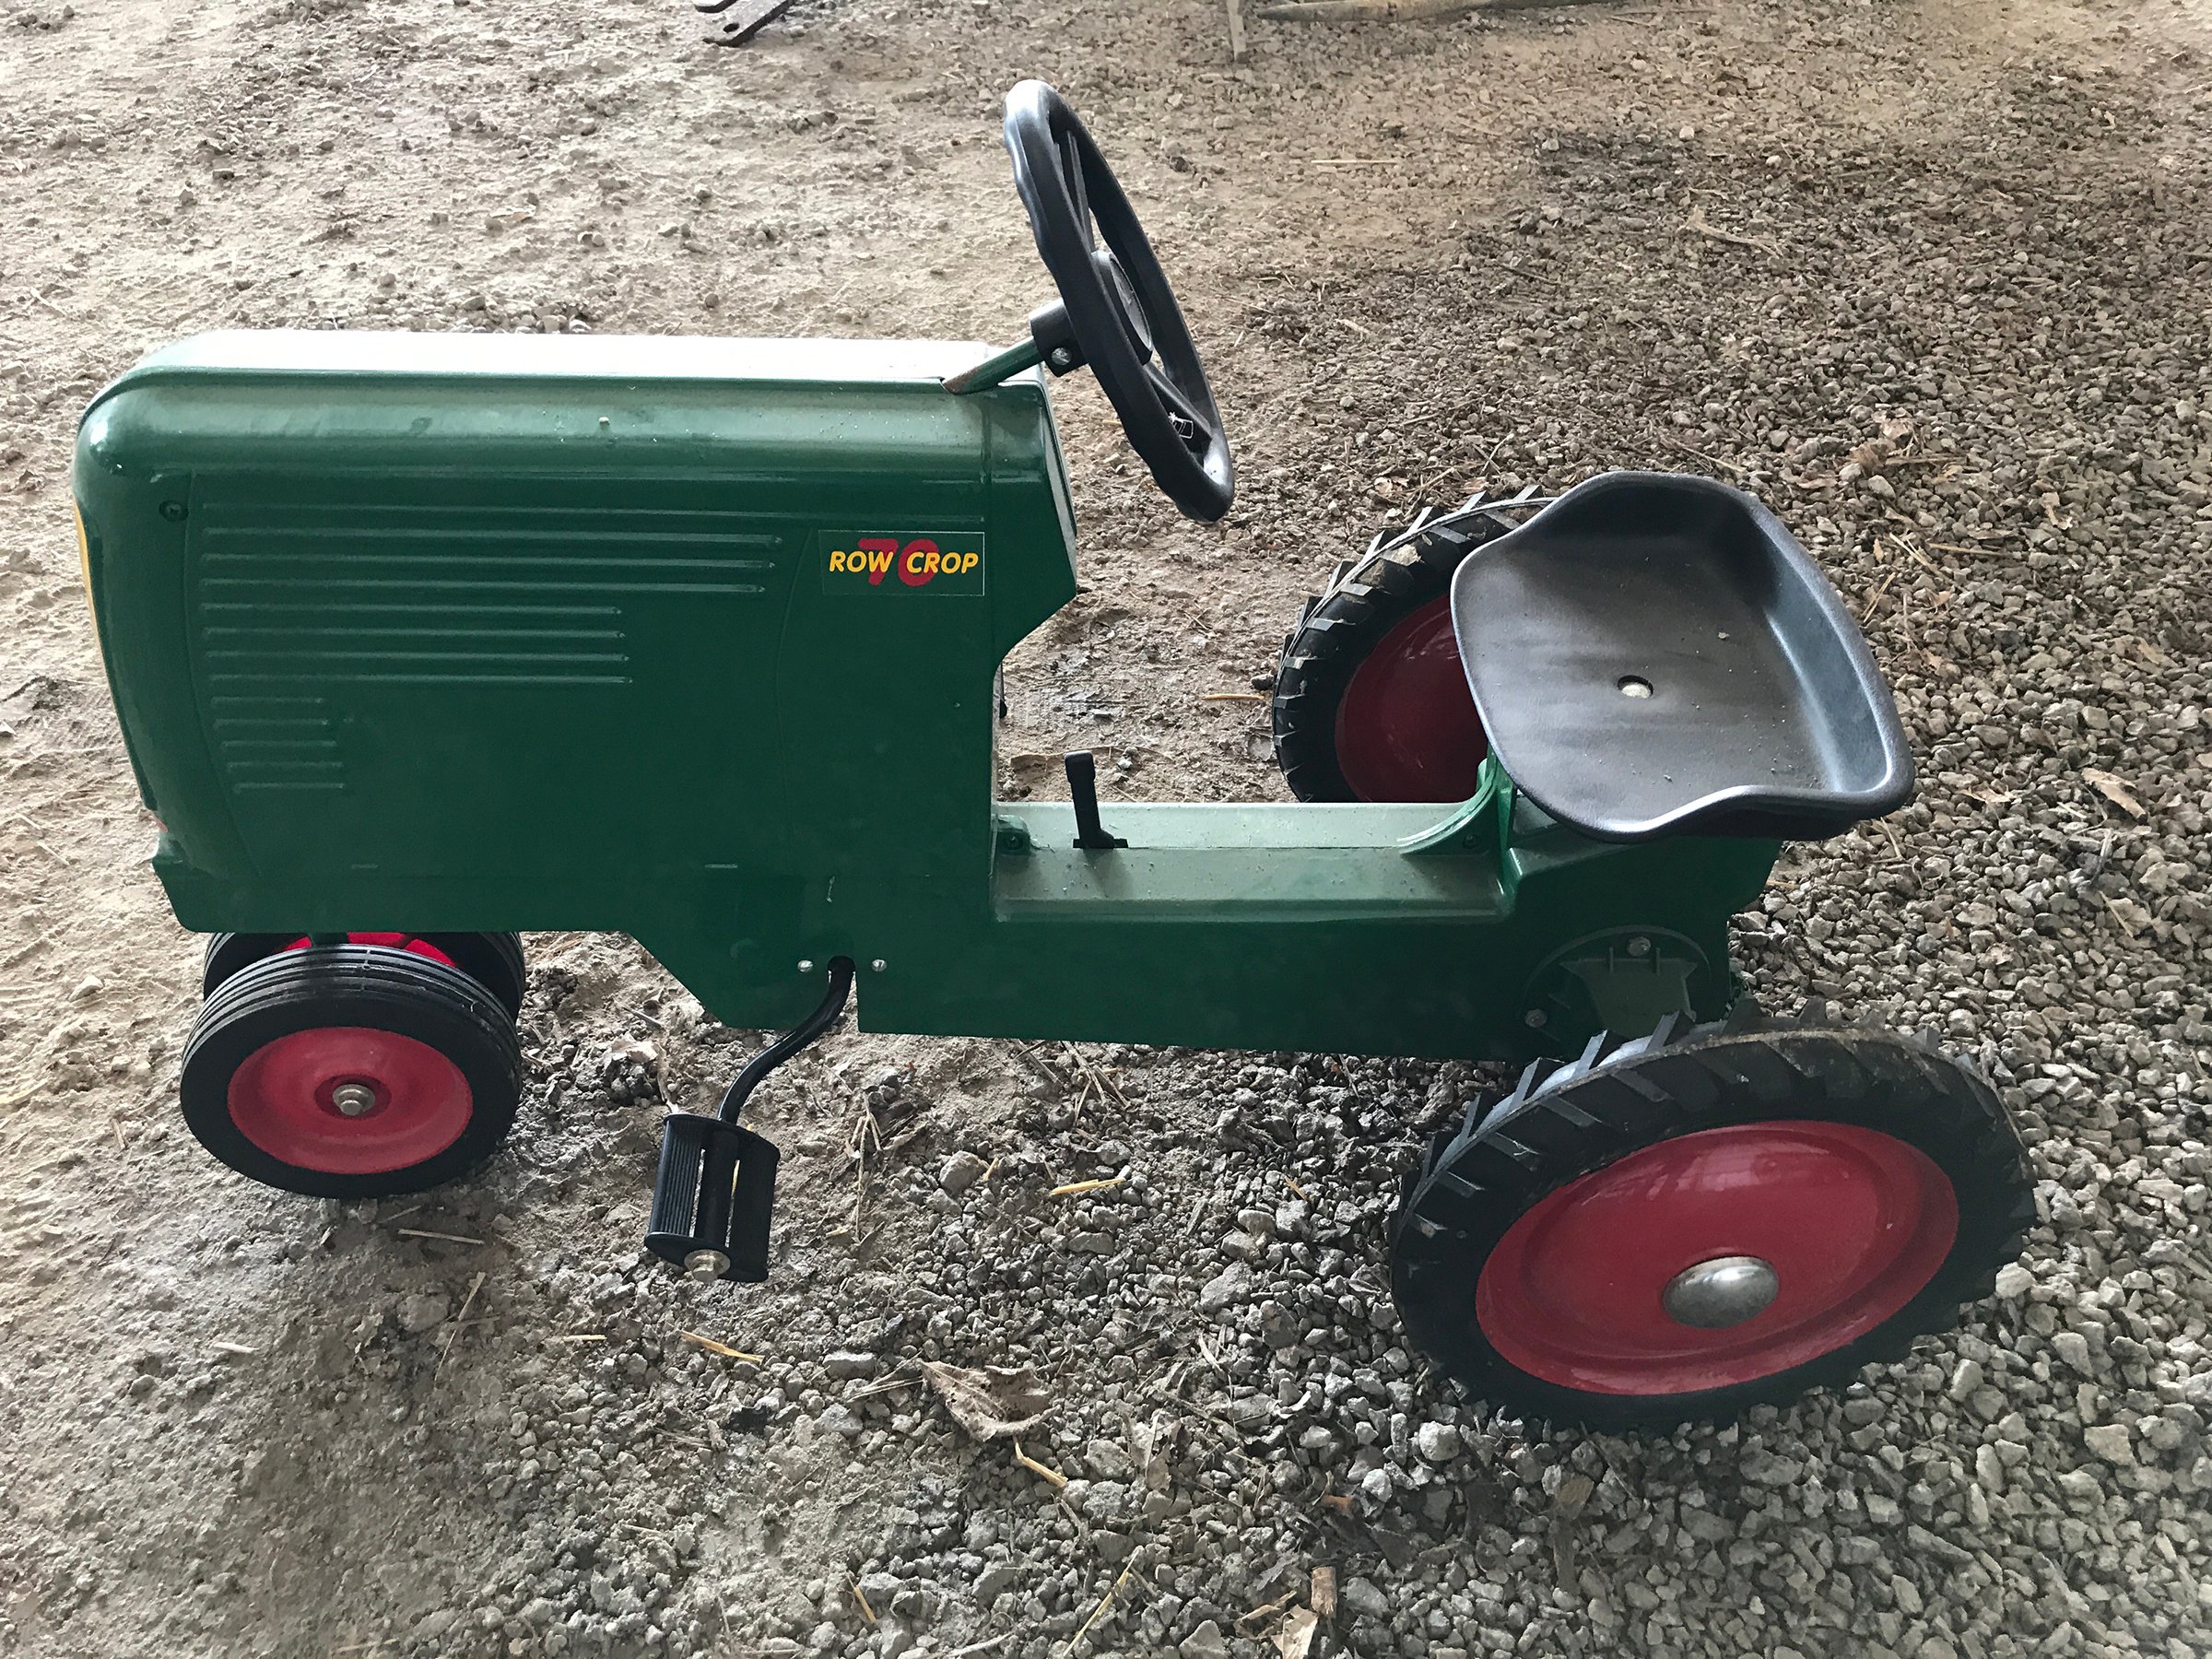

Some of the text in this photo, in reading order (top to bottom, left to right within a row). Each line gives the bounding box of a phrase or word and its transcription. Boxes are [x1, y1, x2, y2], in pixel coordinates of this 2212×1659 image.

[829, 550, 979, 574] ROW CROP
[858, 537, 940, 587] 70
